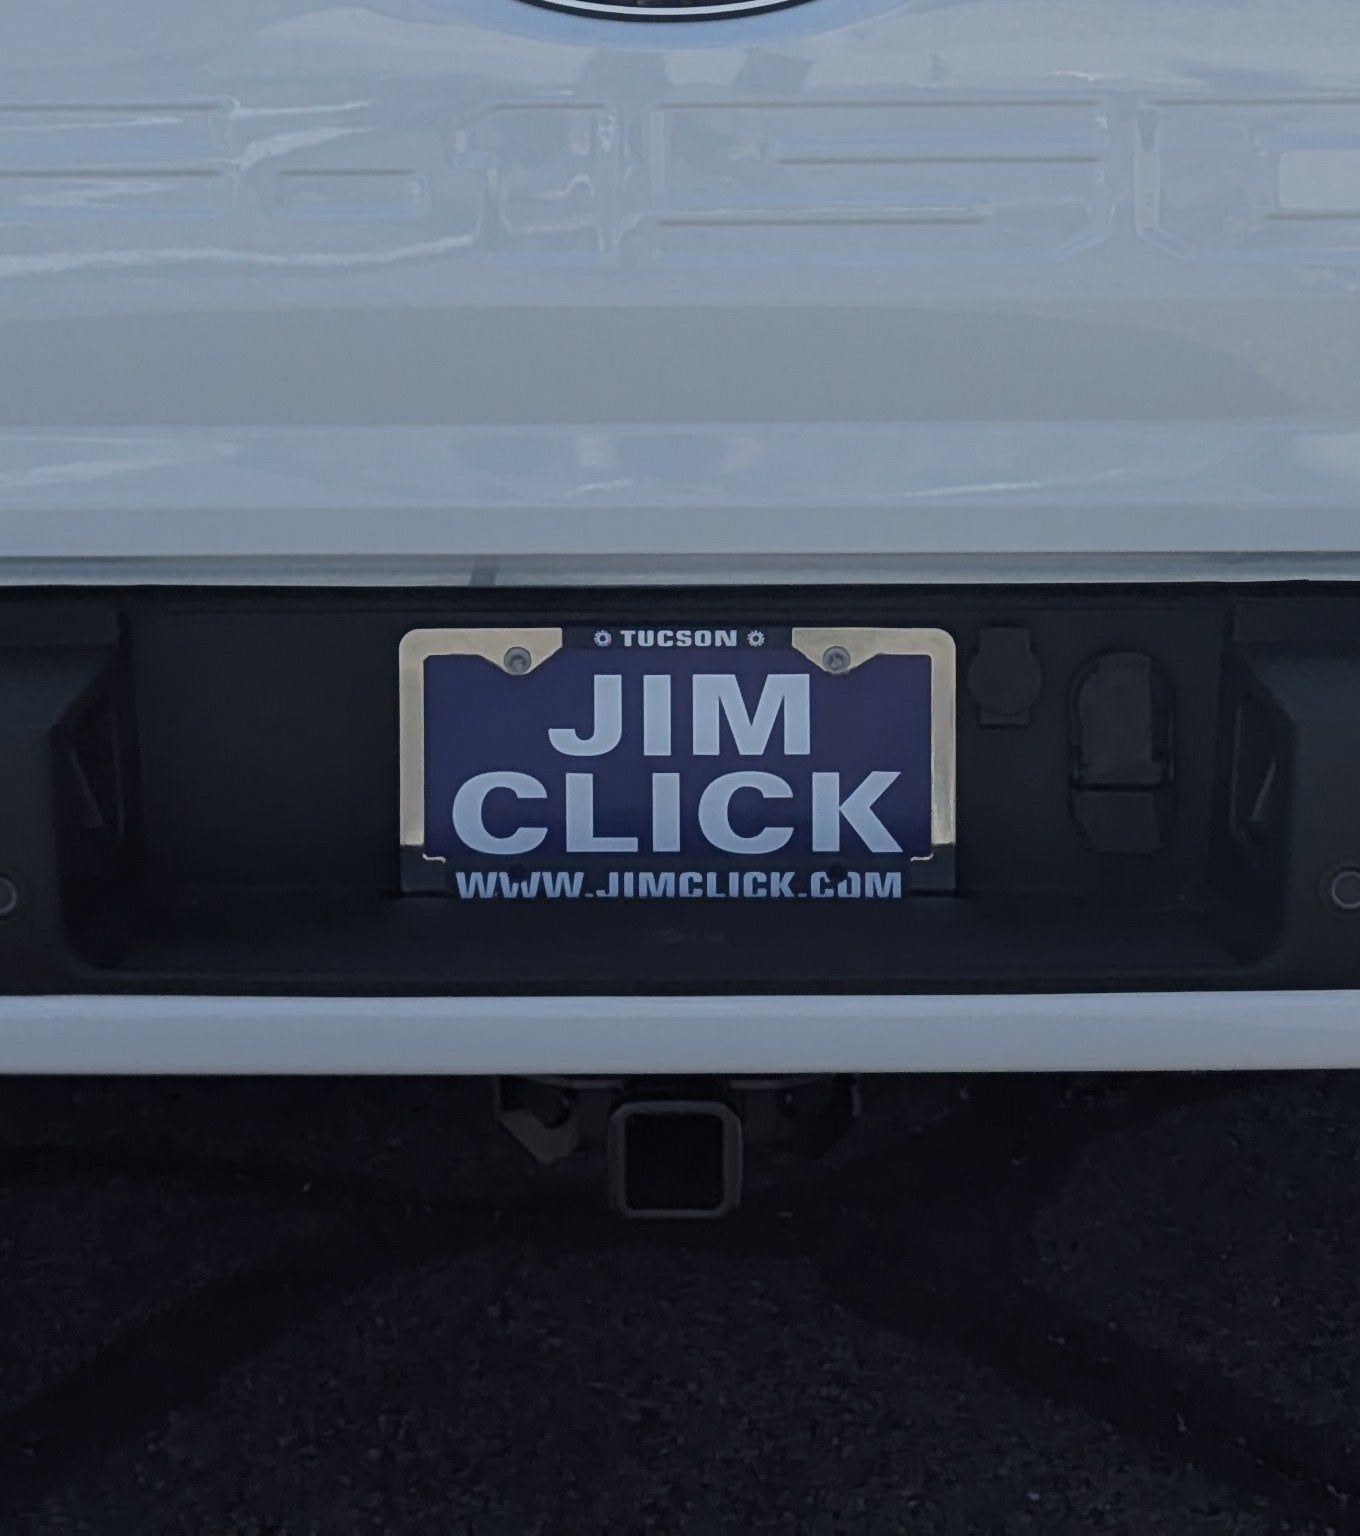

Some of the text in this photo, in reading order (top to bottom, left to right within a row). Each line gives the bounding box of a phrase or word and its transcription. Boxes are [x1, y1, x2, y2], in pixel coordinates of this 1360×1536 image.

[619, 629, 738, 648] TUCSON
[547, 673, 811, 757] JIM
[451, 770, 903, 855] CLICK
[454, 870, 903, 900] WWW.JIMCLICK.COM
